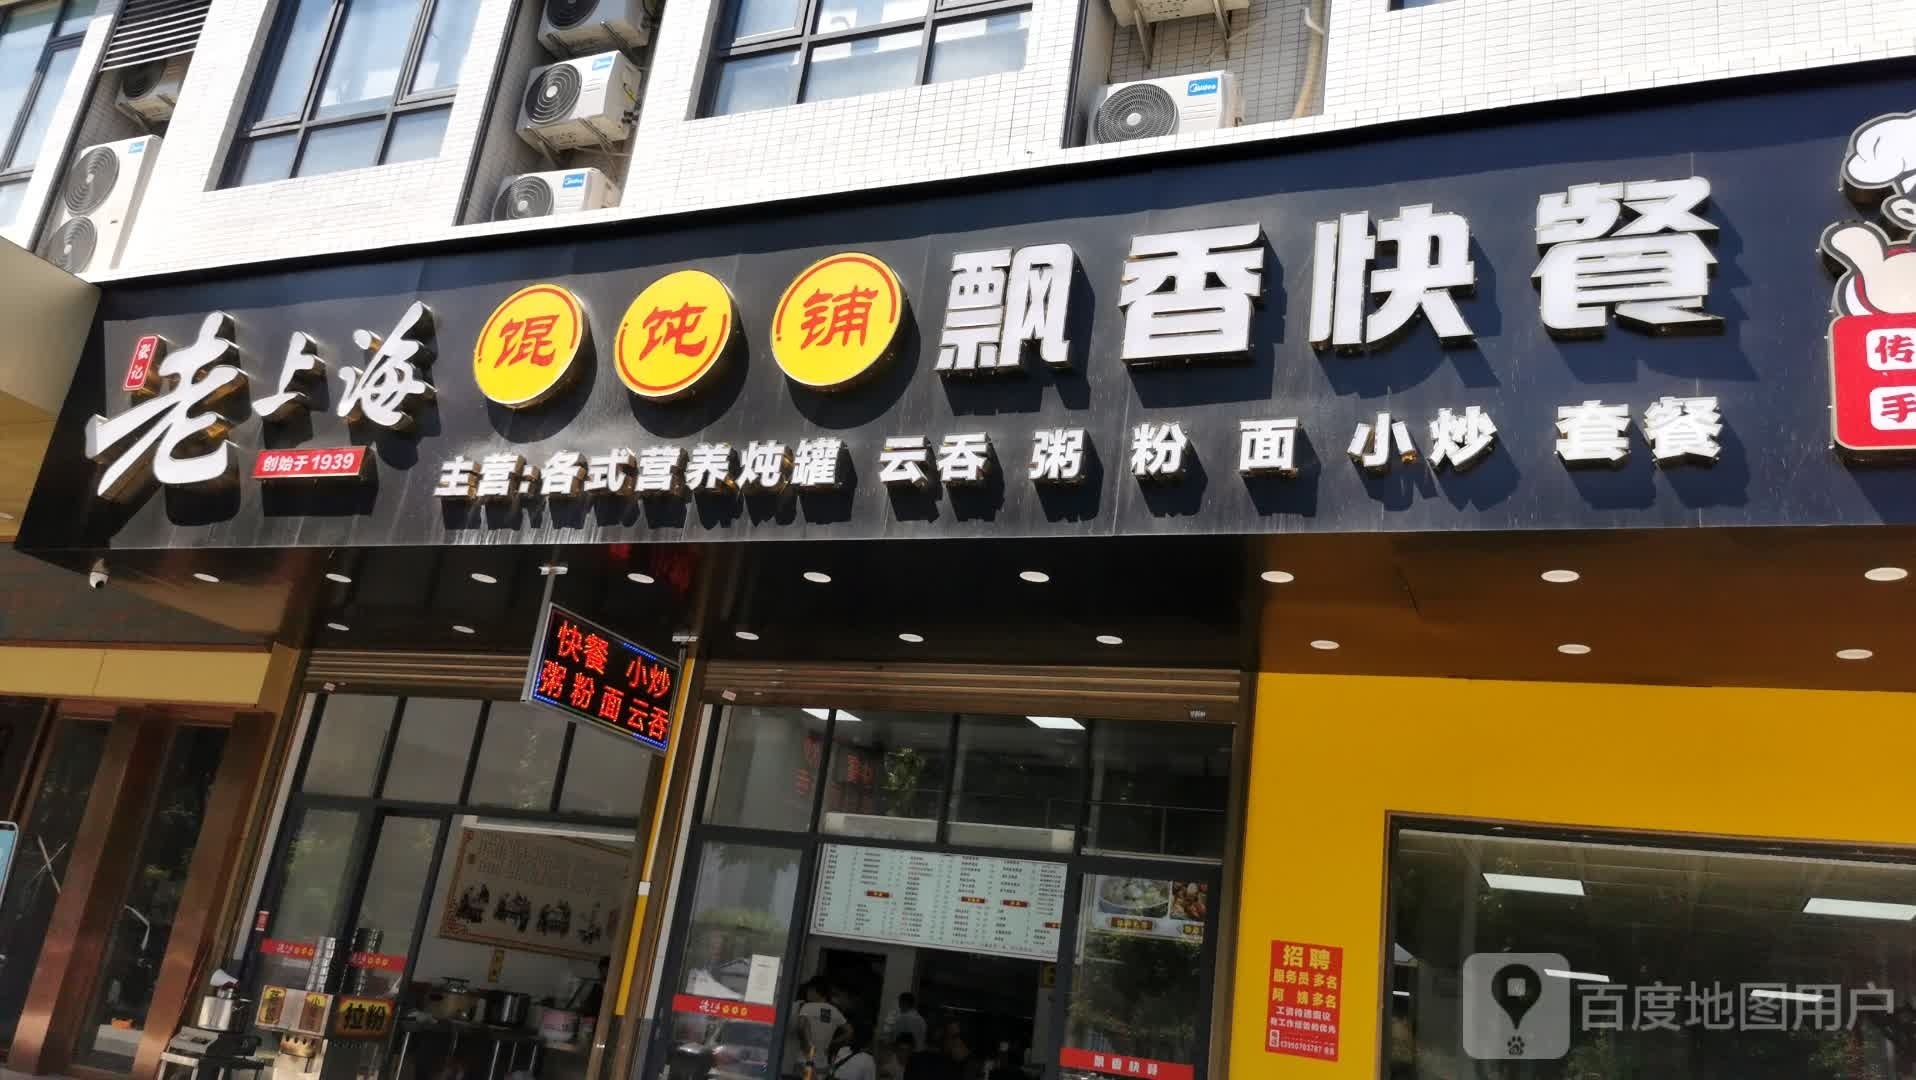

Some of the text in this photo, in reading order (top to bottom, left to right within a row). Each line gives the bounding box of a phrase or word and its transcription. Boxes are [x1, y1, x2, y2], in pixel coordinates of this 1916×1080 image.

[92, 301, 430, 496] 老上海
[937, 178, 1724, 371] 飘香快餐
[1875, 335, 1915, 364] 传
[1881, 392, 1916, 423] 手
[263, 453, 355, 472] 创始于 1939
[879, 433, 988, 484] 云吞
[1029, 427, 1086, 481] 粥
[1131, 423, 1188, 477] 粉
[1238, 417, 1299, 472] 面
[1347, 405, 1498, 469] 小炒
[1556, 396, 1724, 461] 套餐
[557, 620, 671, 698] 快餐 小炒
[539, 660, 669, 740] 粥 粉 面 云吞
[1283, 945, 1330, 970] 招聘
